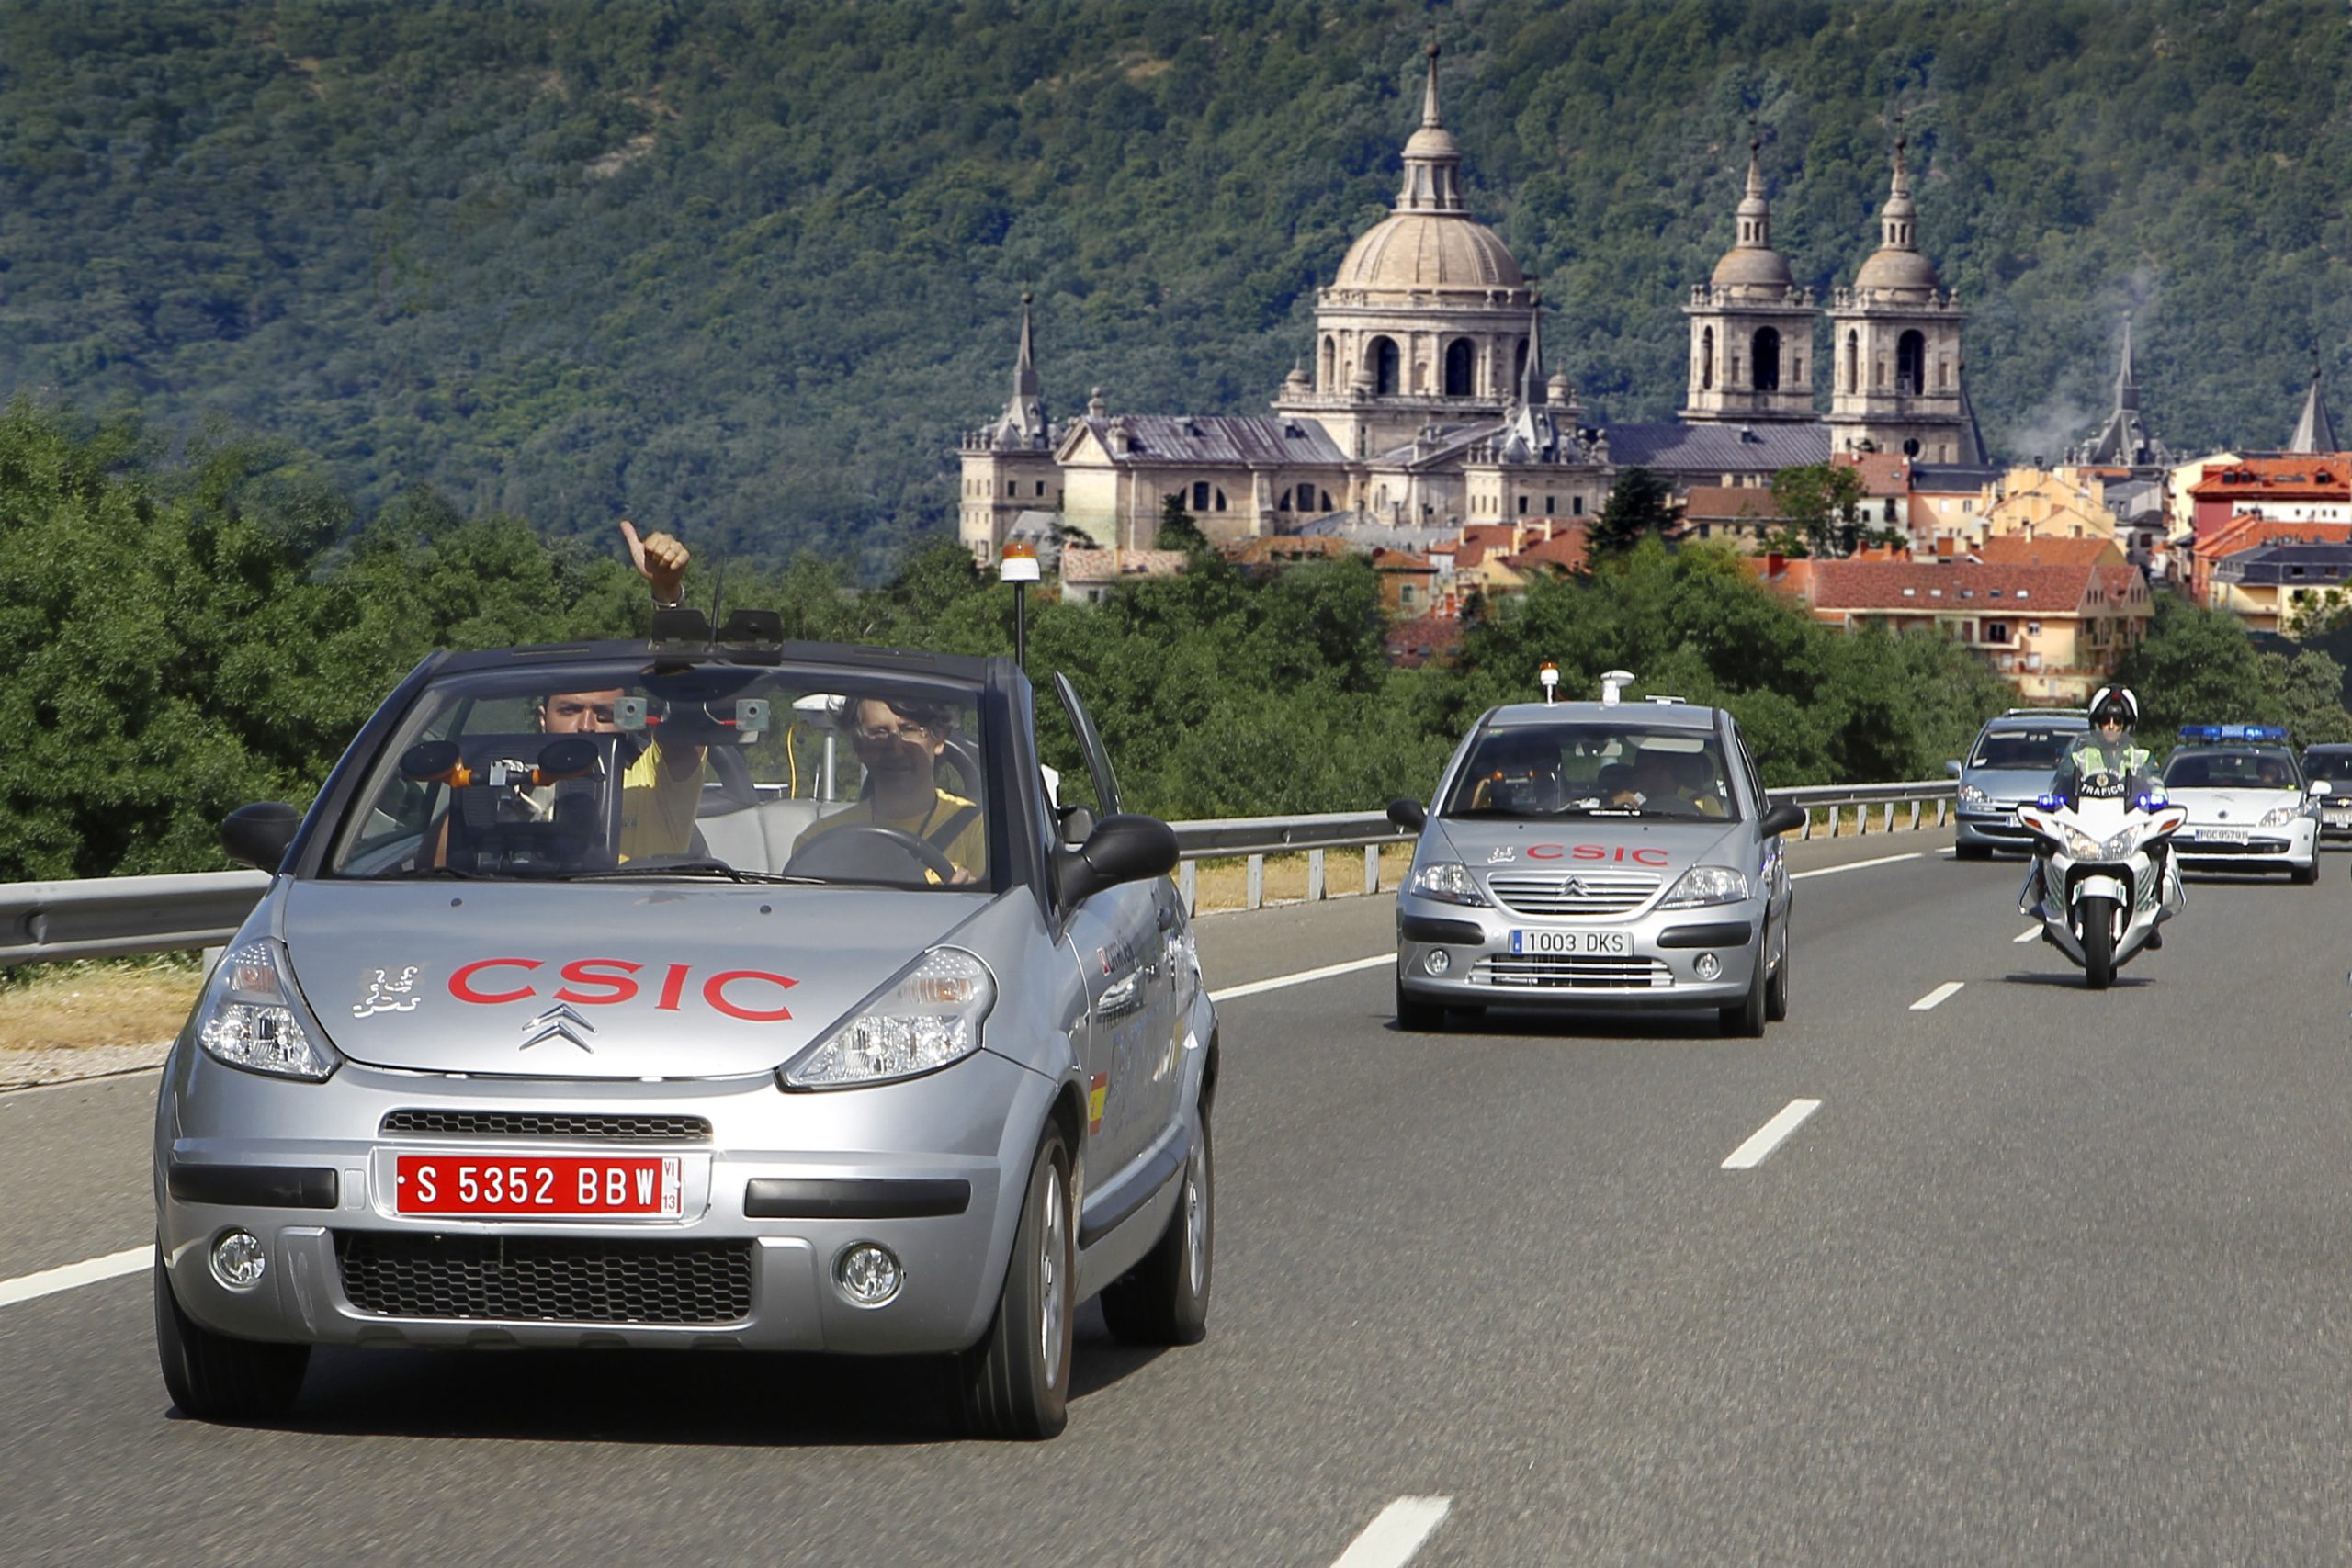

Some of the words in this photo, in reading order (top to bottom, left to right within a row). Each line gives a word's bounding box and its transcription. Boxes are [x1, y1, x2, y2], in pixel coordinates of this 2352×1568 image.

[1527, 843, 1668, 866] CSIC
[1530, 933, 1576, 952] 1003
[1587, 933, 1623, 952] DKS
[447, 957, 800, 1021] CSIC
[417, 1166, 437, 1202] S
[458, 1167, 554, 1204] 5352
[578, 1167, 654, 1205] BBW
[663, 1194, 675, 1209] 13
